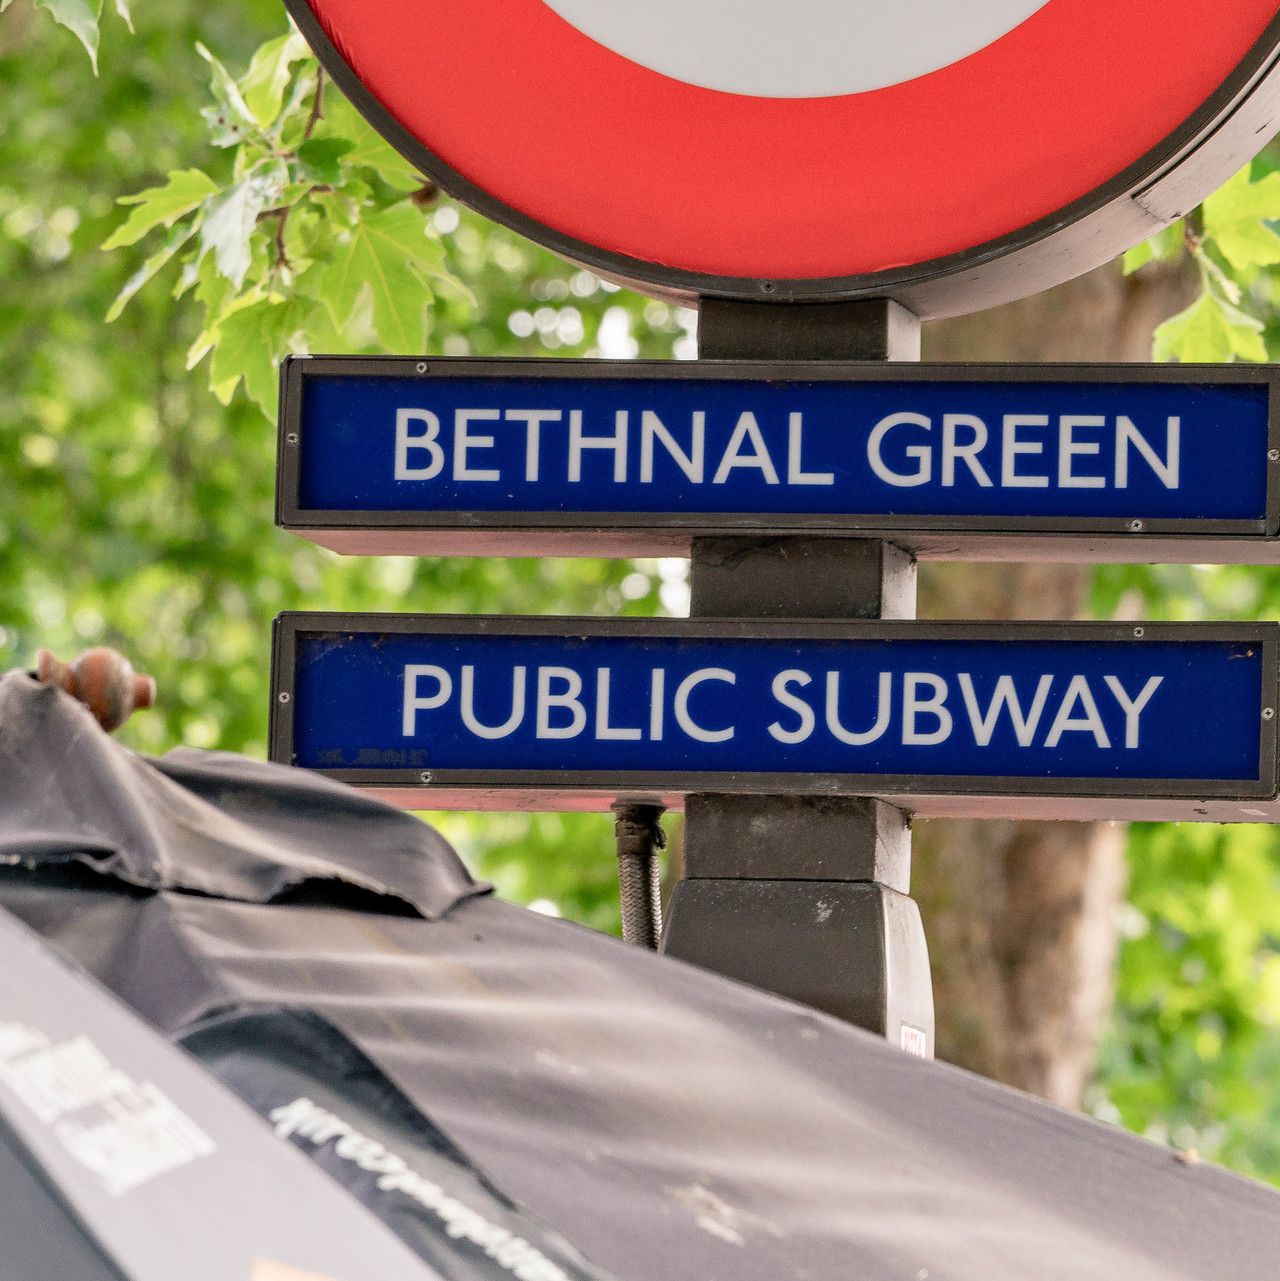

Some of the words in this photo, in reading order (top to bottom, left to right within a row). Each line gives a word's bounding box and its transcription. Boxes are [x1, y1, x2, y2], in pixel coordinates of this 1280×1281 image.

[393, 407, 835, 487] BETHNAL
[867, 411, 1181, 490] GREEN
[401, 663, 735, 743] PUBLIC
[767, 669, 1165, 750] SUBWAY
